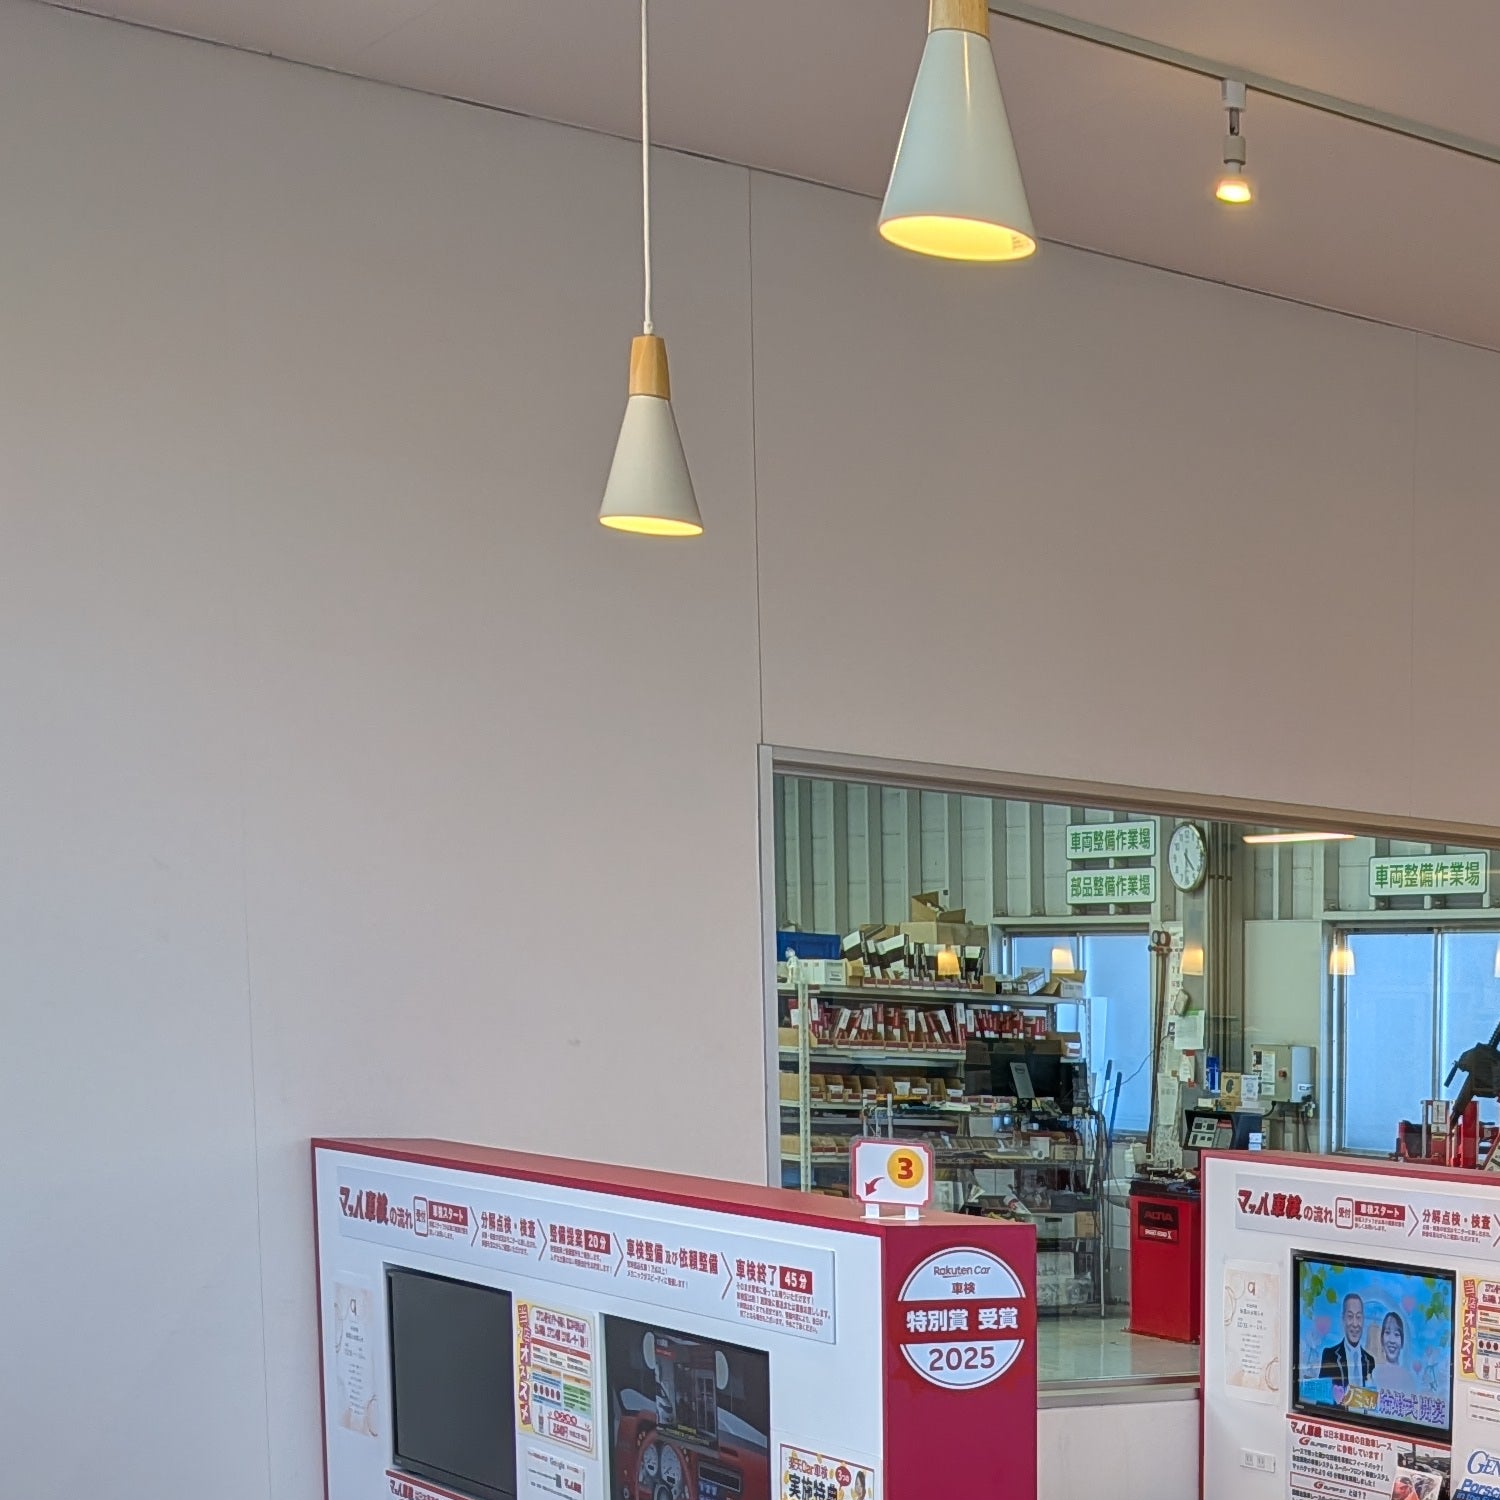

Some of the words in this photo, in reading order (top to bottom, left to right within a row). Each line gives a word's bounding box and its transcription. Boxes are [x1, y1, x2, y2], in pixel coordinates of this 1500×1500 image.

[1070, 828, 1150, 853] 車両整備作業場
[1071, 874, 1150, 897] 部品整備作業場
[1375, 861, 1480, 888] 車両整備作業場
[897, 1157, 914, 1179] 3
[1338, 1207, 1351, 1219] 受付
[1360, 1203, 1400, 1218] 車検スタート
[1422, 1209, 1491, 1230] 分解点検・検査
[736, 1259, 777, 1285] 車検終了
[784, 1272, 807, 1290] 45分
[934, 1265, 973, 1277] Rakuten
[952, 1283, 976, 1295] 車検
[907, 1309, 968, 1333] 特別賞
[978, 1307, 1018, 1330] 受賞
[929, 1346, 995, 1371] 2025
